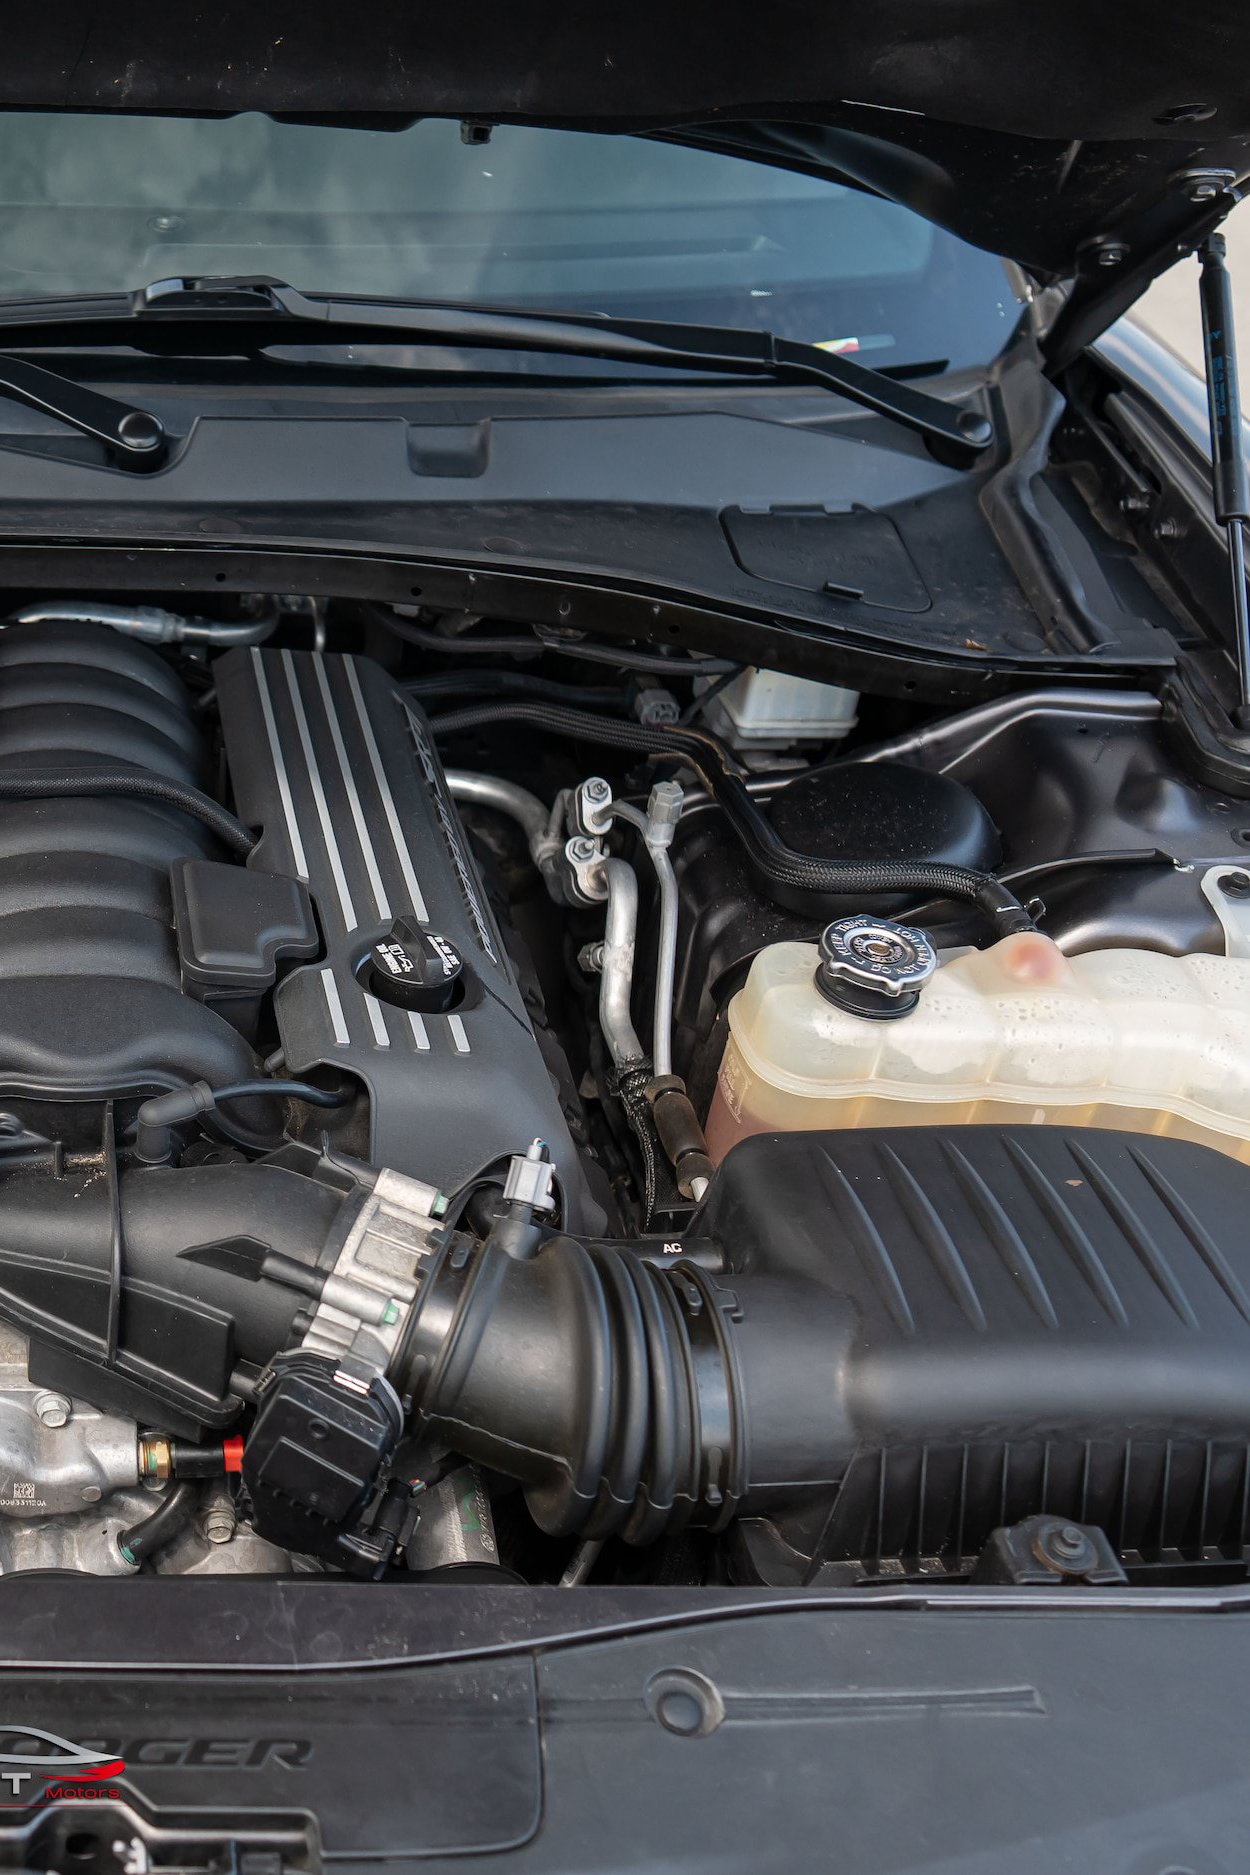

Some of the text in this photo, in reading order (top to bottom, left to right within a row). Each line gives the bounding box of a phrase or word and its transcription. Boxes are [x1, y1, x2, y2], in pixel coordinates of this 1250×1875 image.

[831, 919, 868, 956] KEEP TIGHT
[893, 928, 920, 946] HOT
[382, 952, 403, 974] ENGINE
